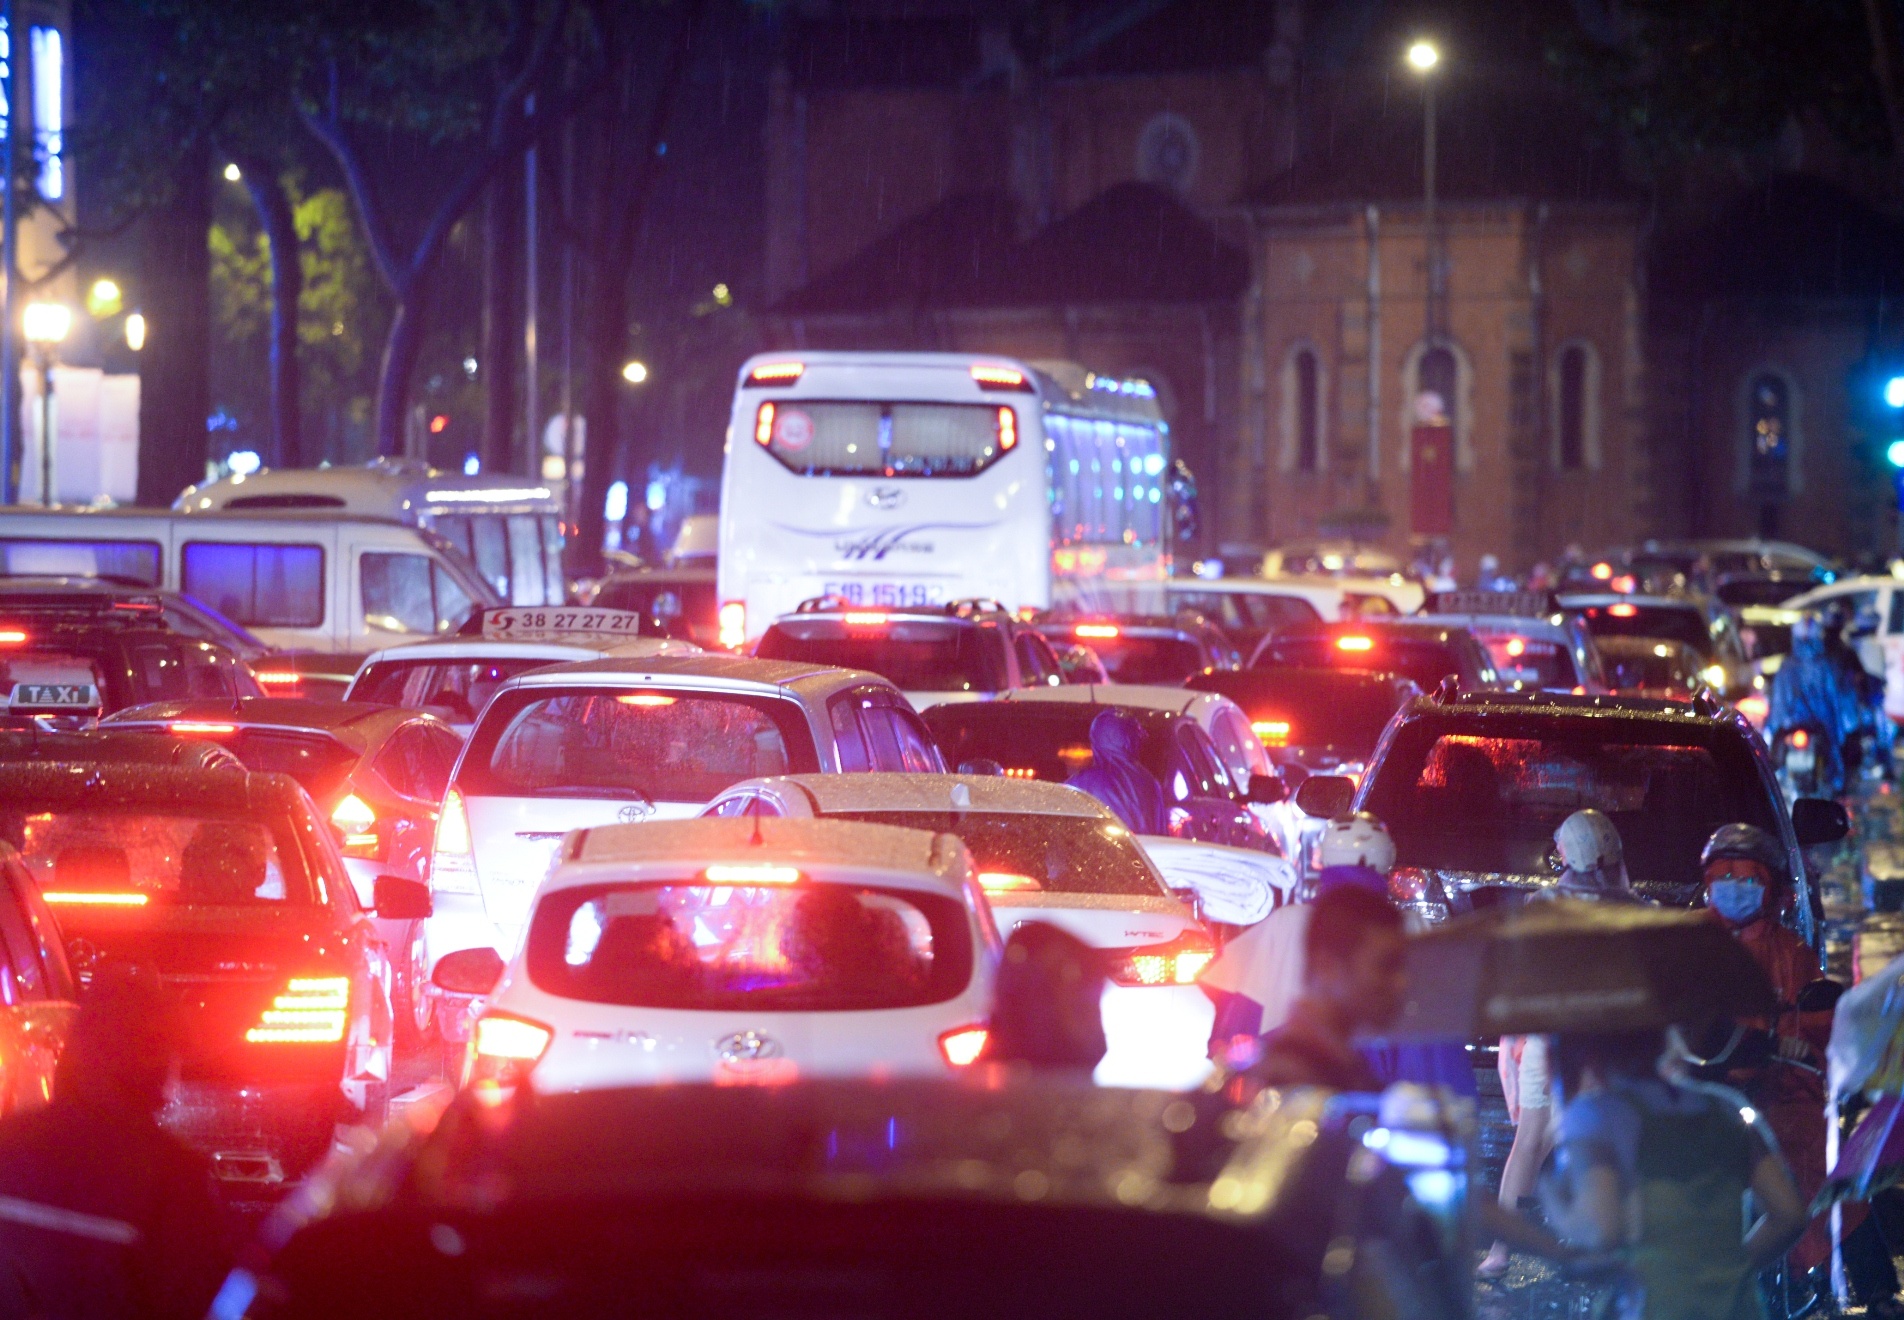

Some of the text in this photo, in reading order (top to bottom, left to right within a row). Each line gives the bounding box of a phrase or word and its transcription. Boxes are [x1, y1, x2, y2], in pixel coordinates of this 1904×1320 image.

[522, 612, 635, 630] 38 27 27 27
